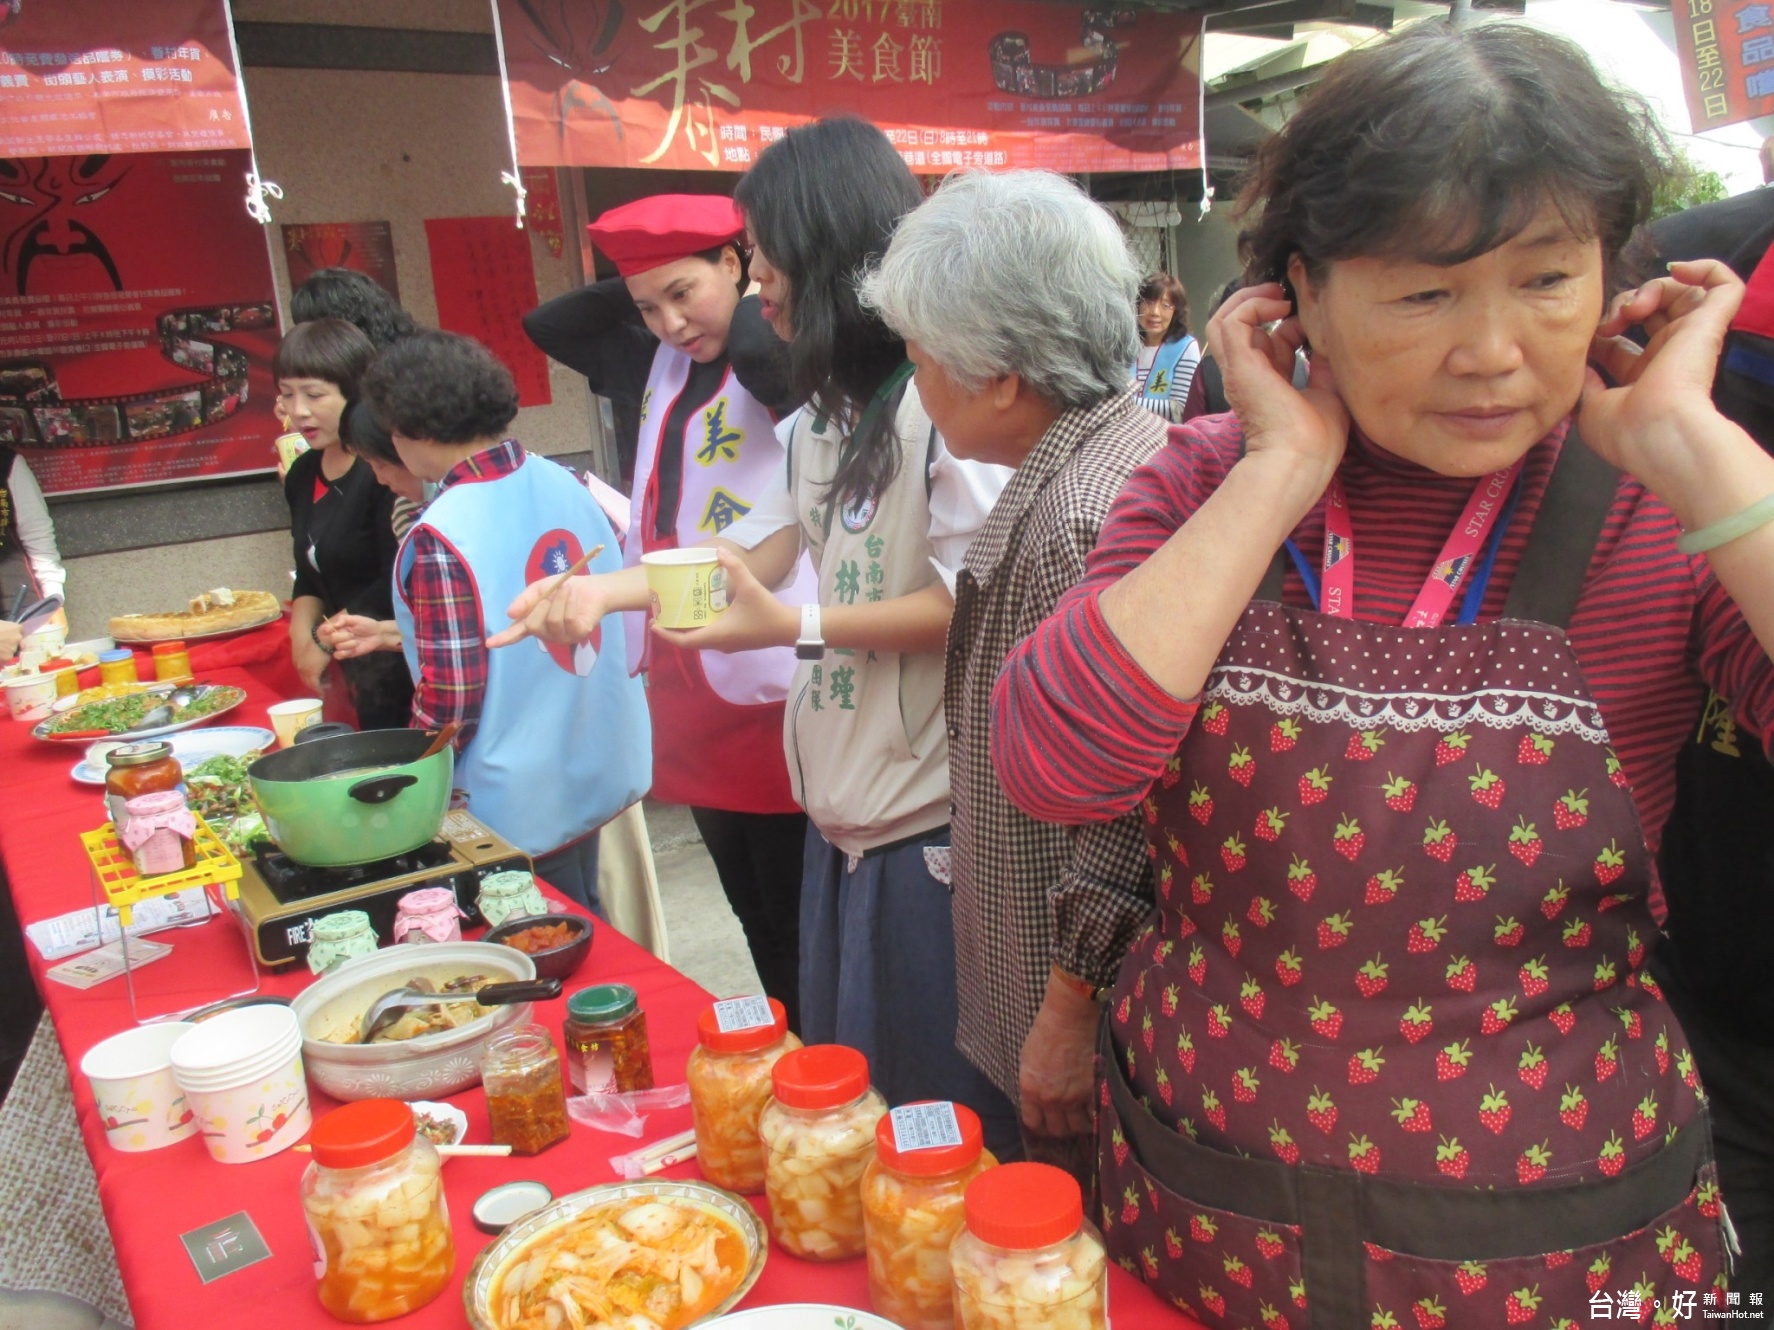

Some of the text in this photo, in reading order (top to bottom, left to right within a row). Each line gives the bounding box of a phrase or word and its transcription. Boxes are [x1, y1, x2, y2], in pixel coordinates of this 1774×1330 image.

[828, 29, 942, 85] 美食節
[1465, 500, 1494, 538] STAR
